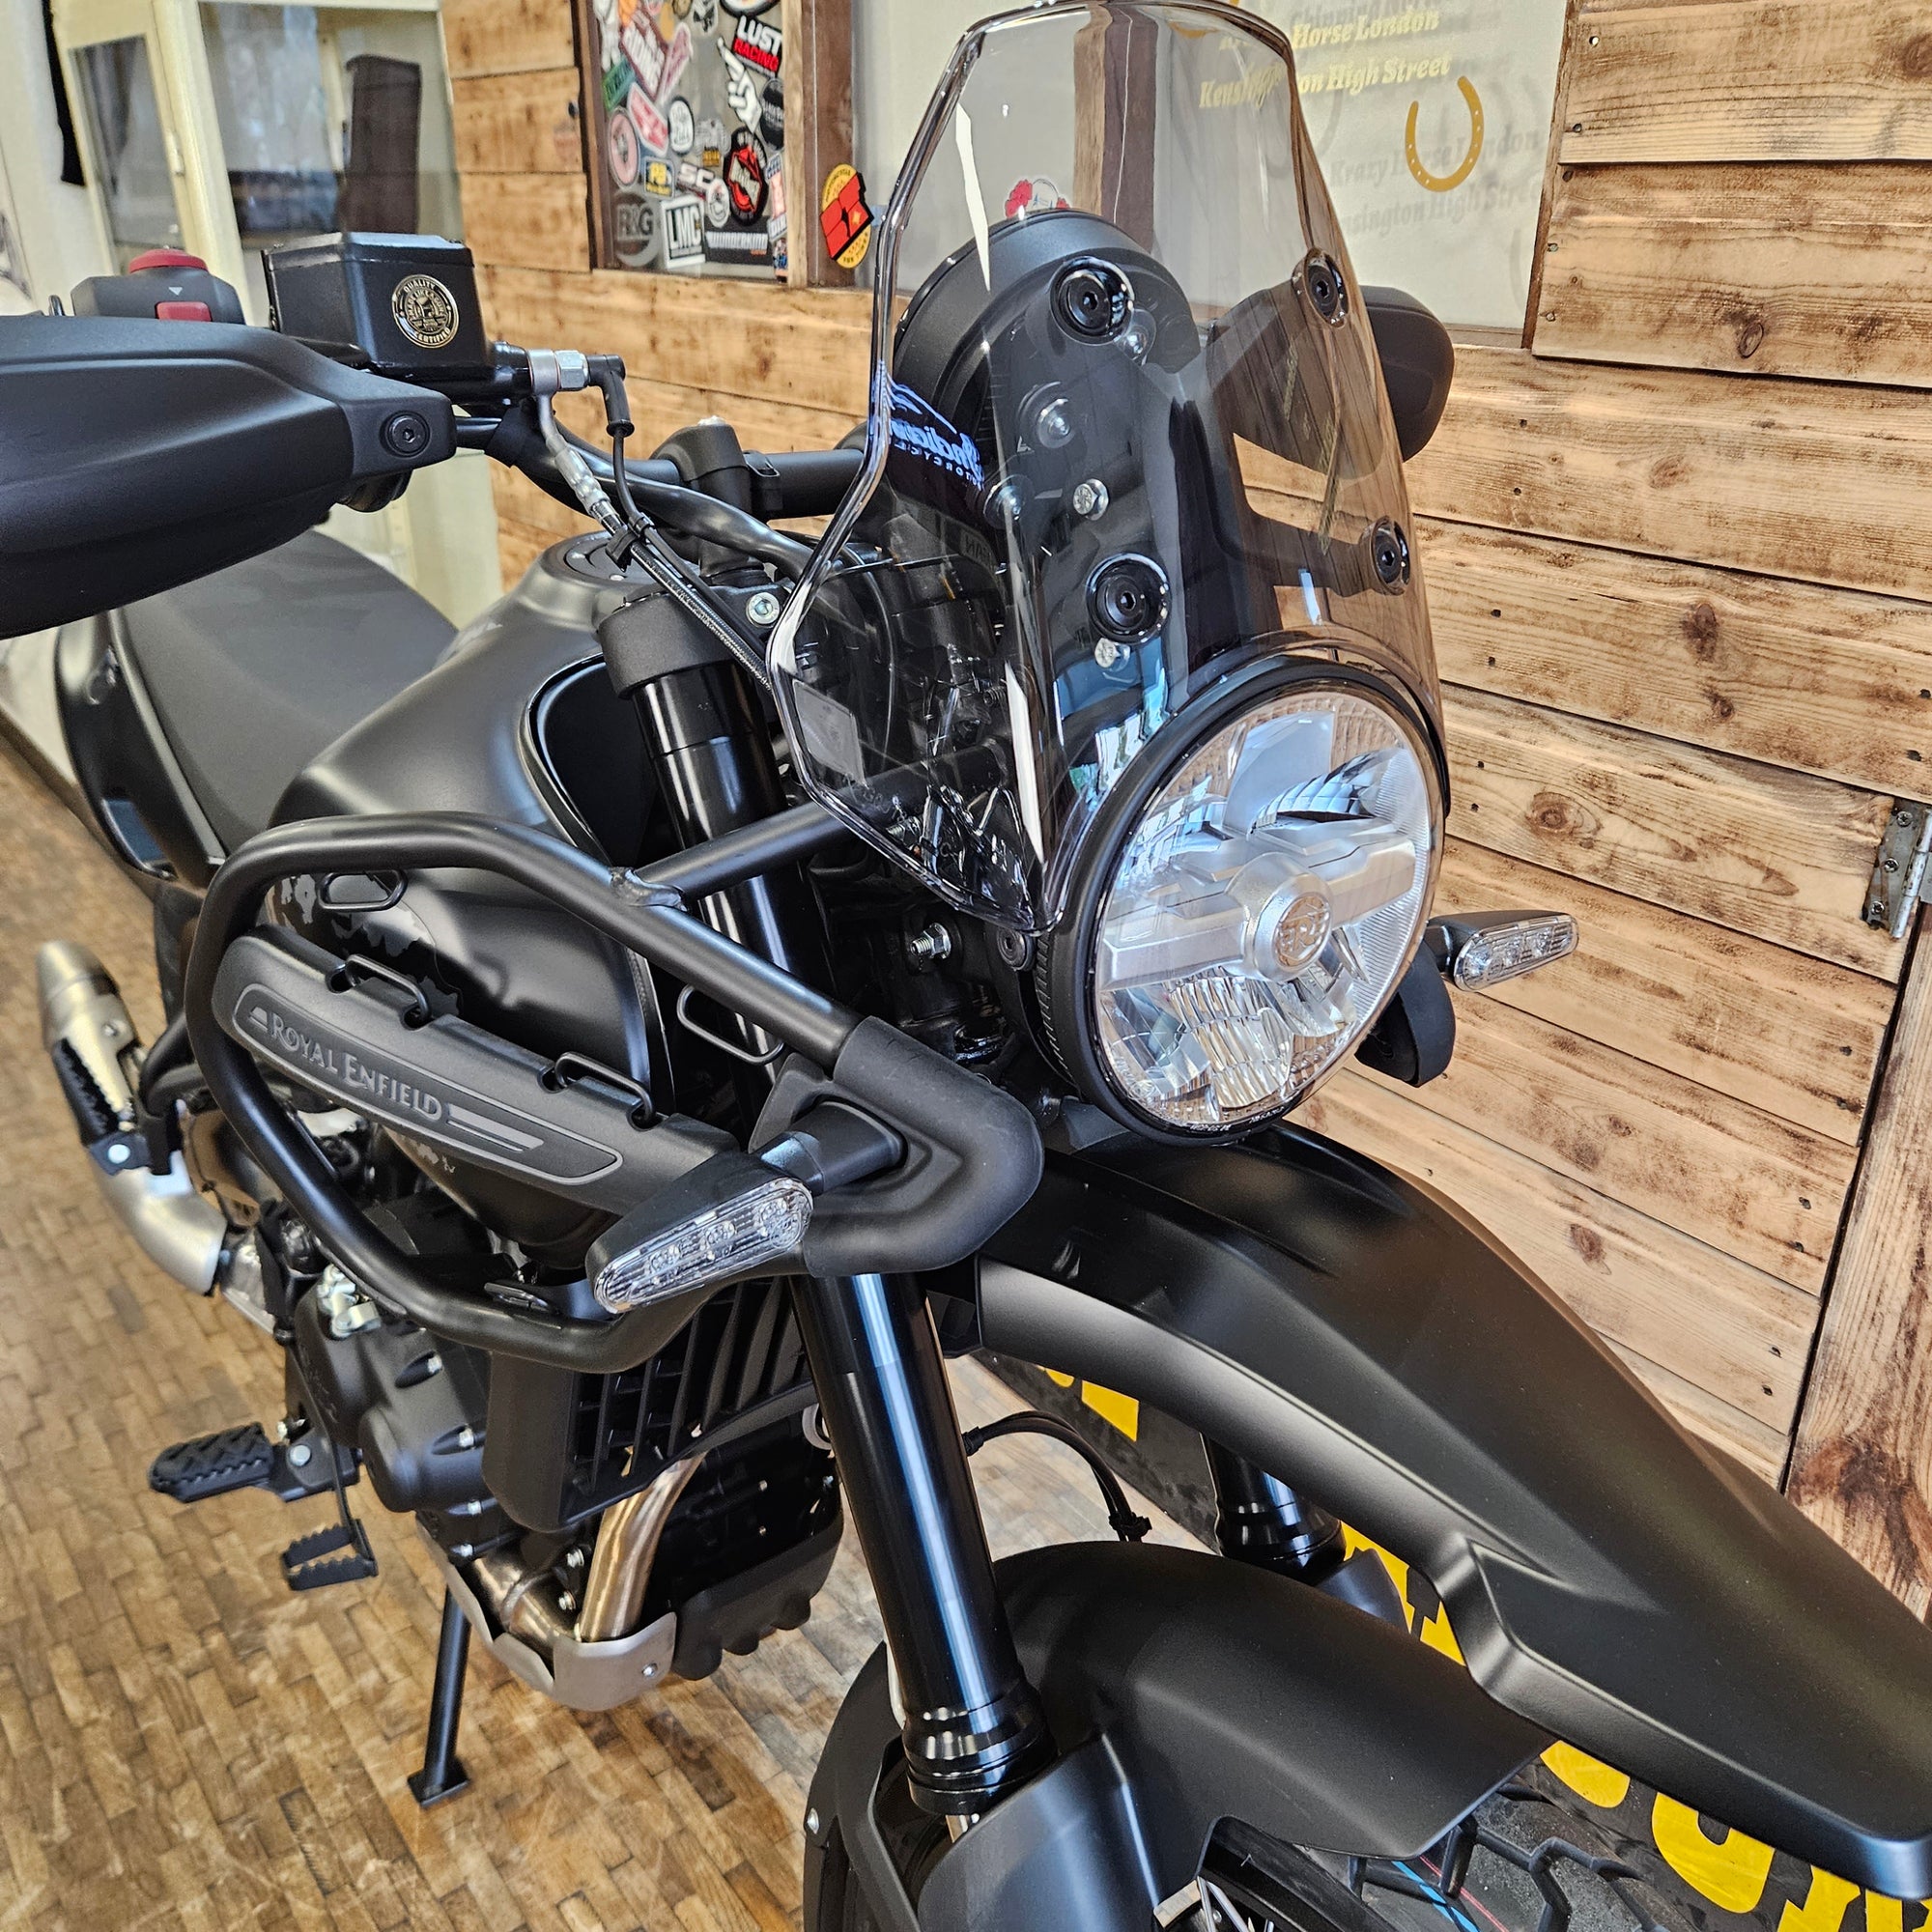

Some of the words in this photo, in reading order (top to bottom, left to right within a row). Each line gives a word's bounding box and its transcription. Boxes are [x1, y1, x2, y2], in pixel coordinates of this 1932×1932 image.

[737, 14, 782, 56] LUST
[1291, 22, 1352, 49] Horse
[1354, 6, 1440, 41] London
[734, 39, 779, 71] RACING
[1325, 59, 1380, 96] High
[1381, 52, 1453, 84] Street
[667, 205, 702, 250] LMC
[403, 278, 436, 293] QUALITY
[271, 1012, 338, 1075] ROYAL
[341, 1051, 442, 1122] ENFIELD
